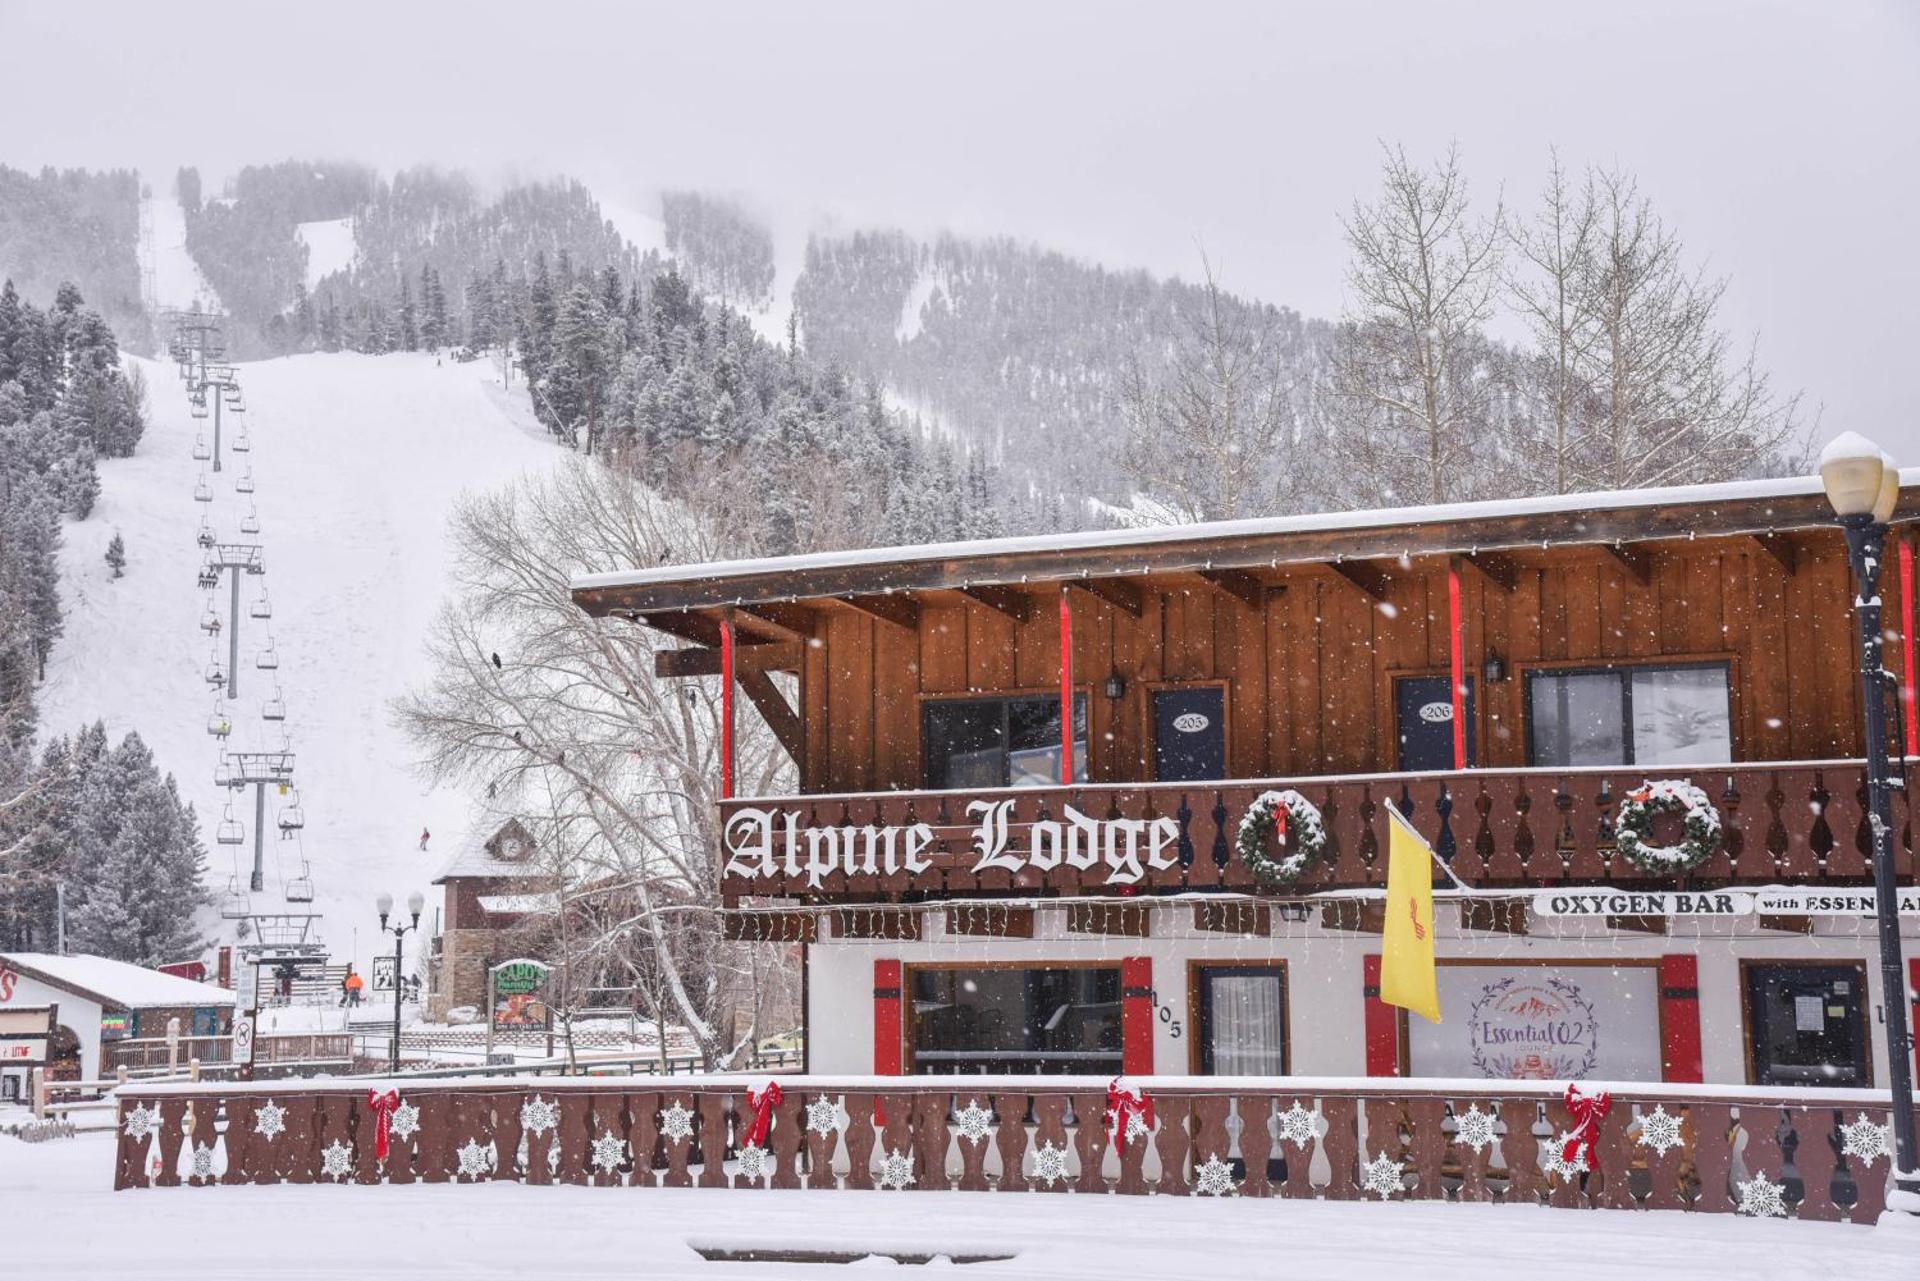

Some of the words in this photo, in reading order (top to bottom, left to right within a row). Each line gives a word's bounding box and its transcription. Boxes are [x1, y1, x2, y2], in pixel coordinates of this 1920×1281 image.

[1426, 706, 1450, 718] 206
[724, 807, 934, 889] Alpine
[966, 799, 1180, 884] Lodge
[1550, 895, 1666, 914] OXYGEN
[1675, 895, 1735, 914] BAR
[1763, 898, 1799, 909] with
[1151, 991, 1181, 1038] 105
